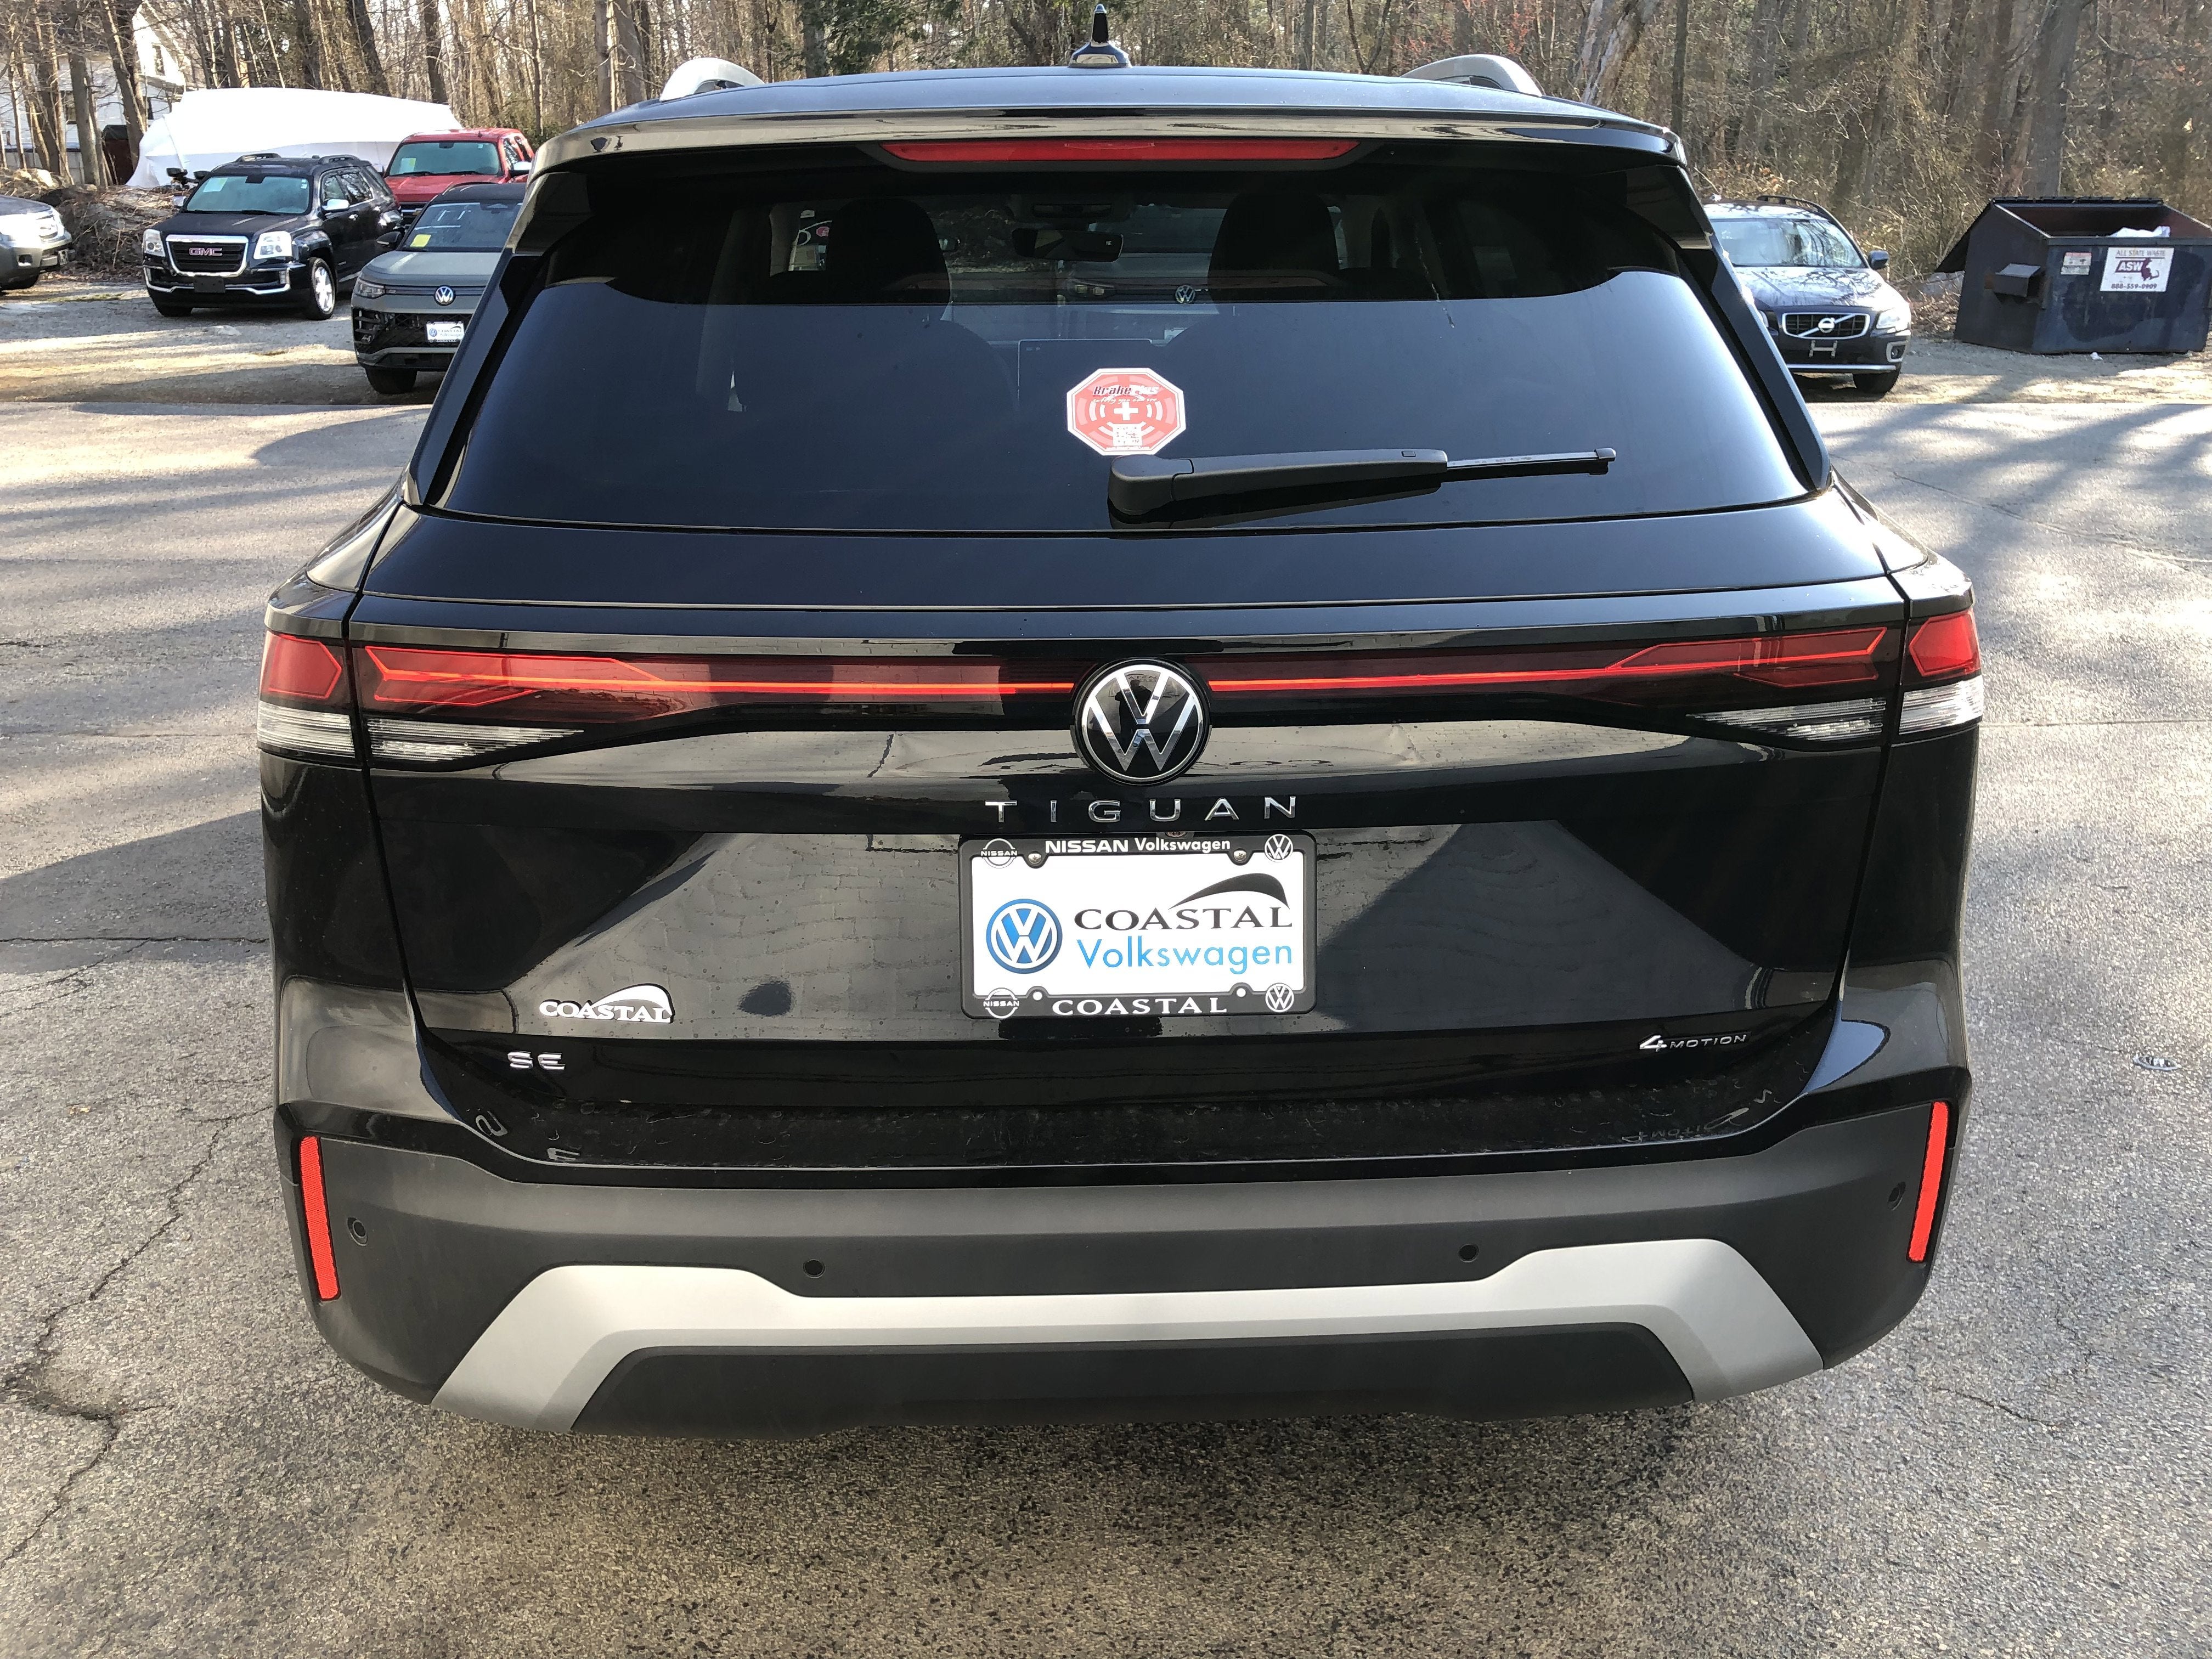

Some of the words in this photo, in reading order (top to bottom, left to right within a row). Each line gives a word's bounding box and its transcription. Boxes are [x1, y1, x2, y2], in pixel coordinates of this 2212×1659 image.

[189, 247, 223, 256] GMC
[2118, 261, 2144, 271] ASW
[1093, 386, 1132, 395] Brake
[985, 795, 1296, 823] TIGUAN
[1045, 839, 1129, 854] NISSAN
[1135, 837, 1231, 852] Volkswagen
[1074, 906, 1293, 931] COASTAL
[1076, 935, 1293, 975] Volkswagen
[539, 1000, 673, 1024] COASTAL
[1052, 997, 1227, 1016] COASTAL
[1639, 1034, 1747, 1053] 4MOTION
[507, 1050, 566, 1070] SE
